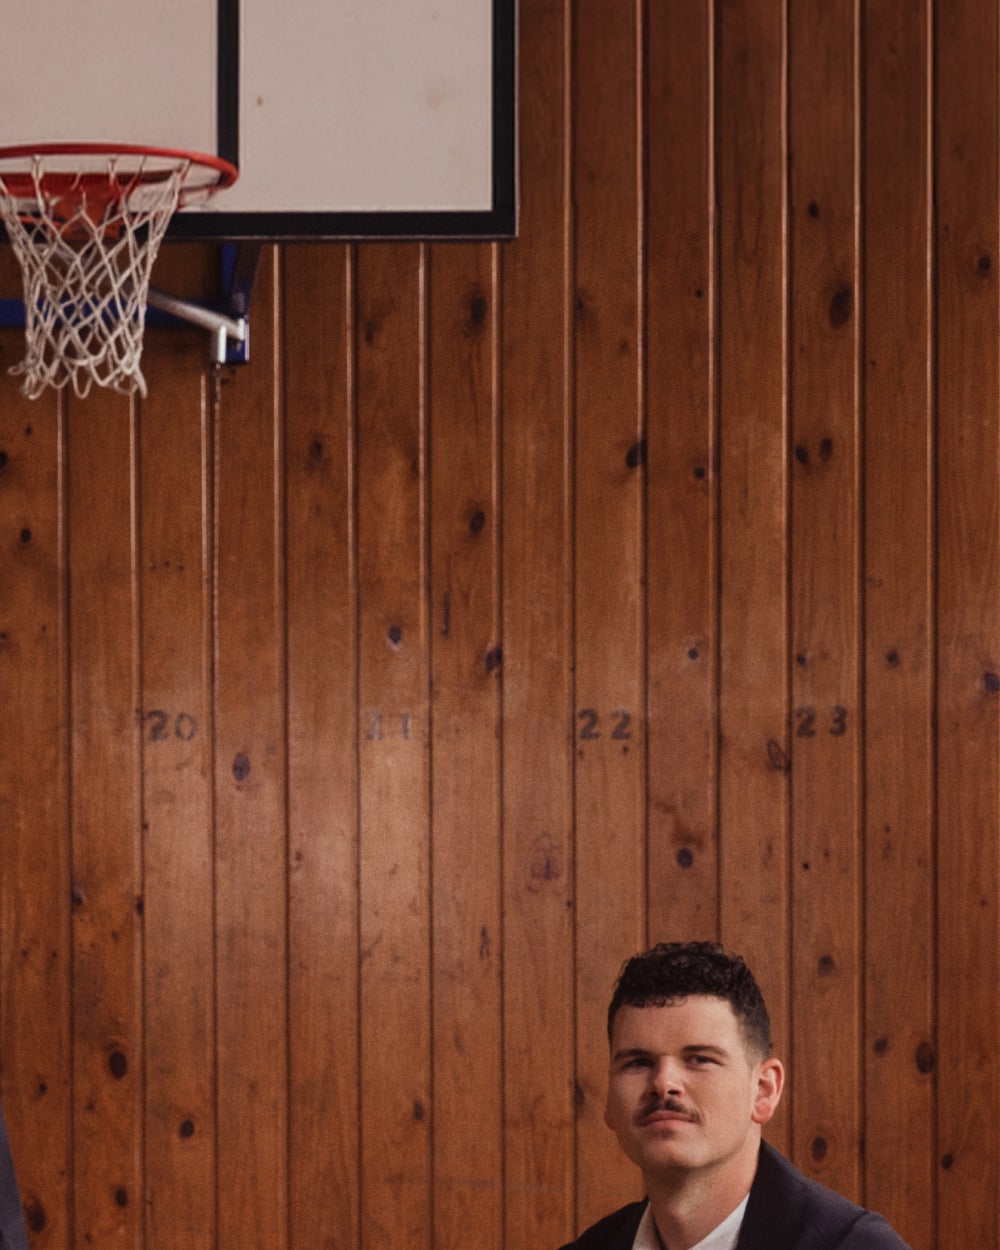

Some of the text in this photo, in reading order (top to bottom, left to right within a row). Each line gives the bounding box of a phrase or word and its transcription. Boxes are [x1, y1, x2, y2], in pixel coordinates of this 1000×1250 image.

[147, 709, 198, 740] 20
[578, 708, 632, 739] 22
[795, 705, 847, 736] 23
